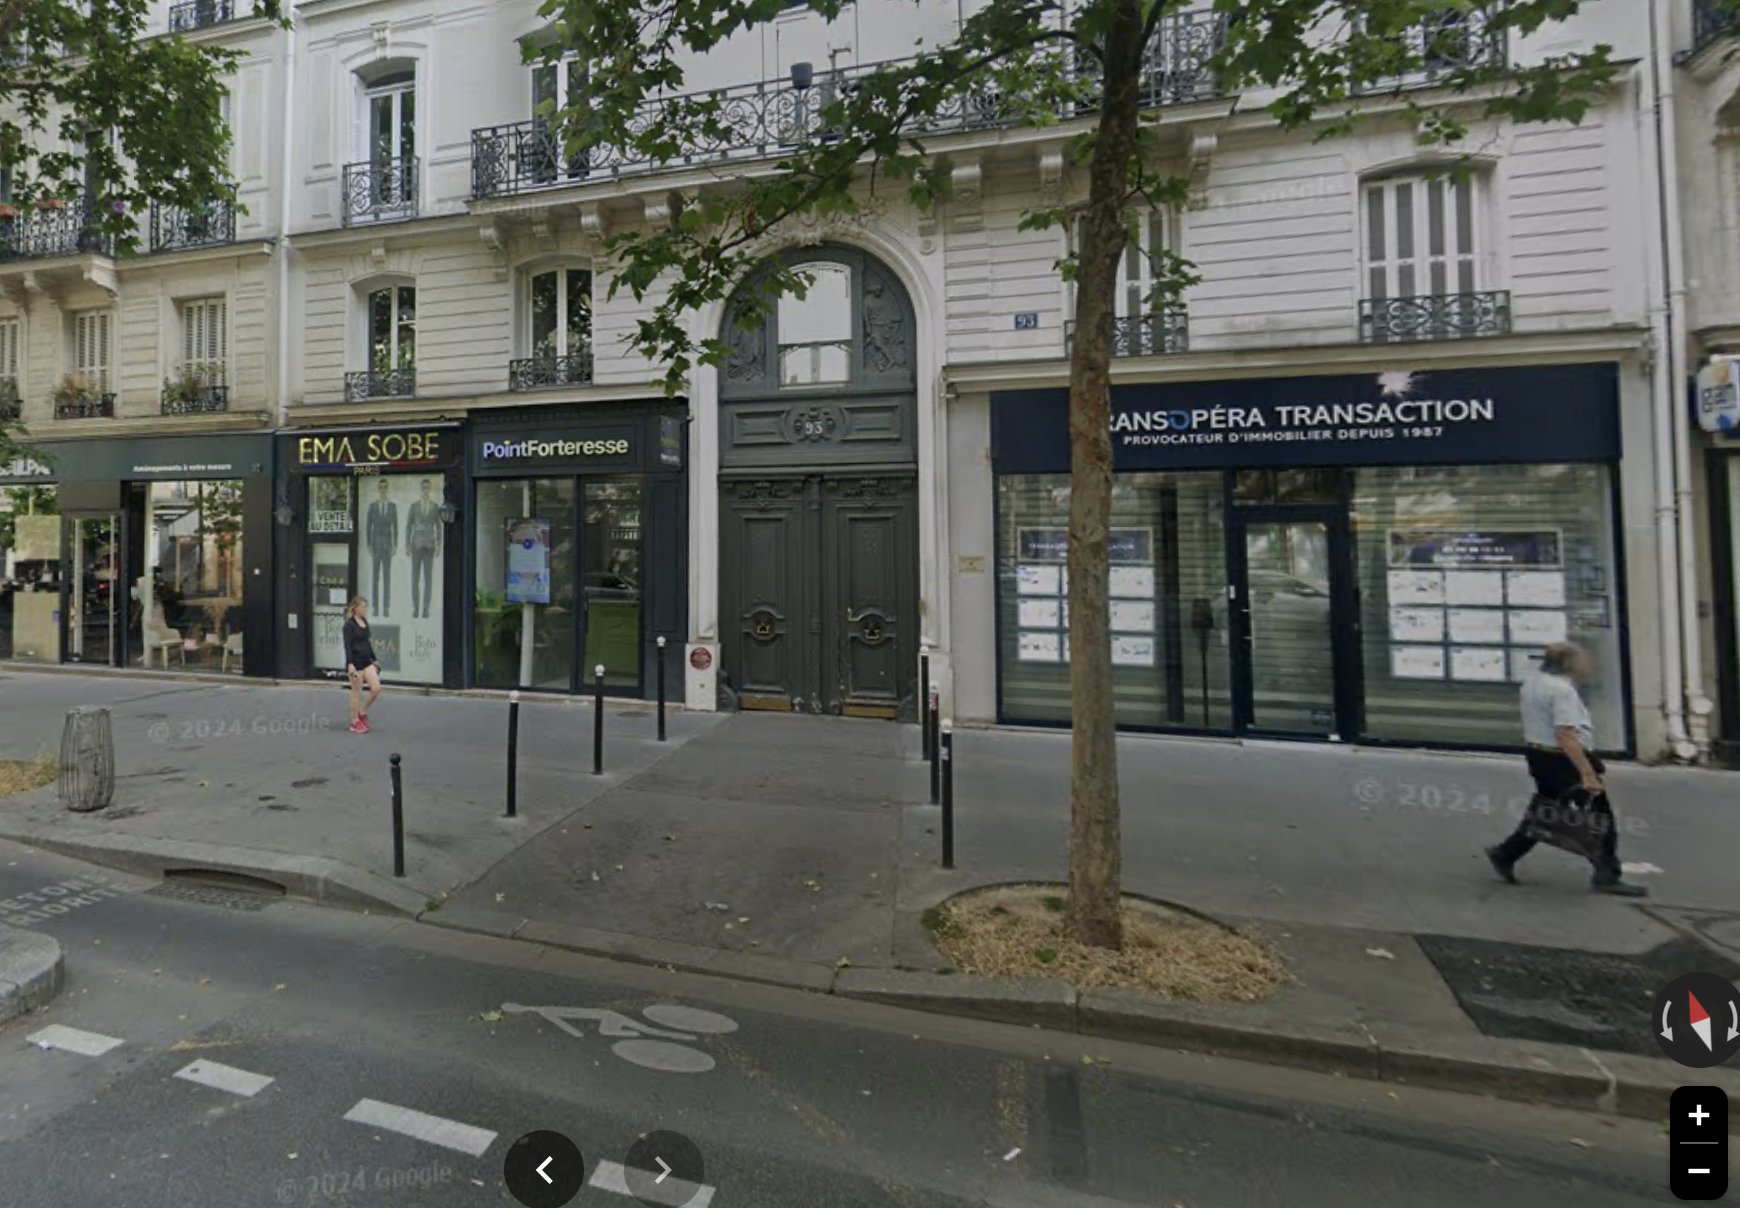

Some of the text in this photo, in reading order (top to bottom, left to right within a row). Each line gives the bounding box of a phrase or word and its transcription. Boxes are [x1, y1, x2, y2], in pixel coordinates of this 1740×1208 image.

[1110, 399, 1494, 431] ANSOPÉRA TRANSACTION
[1123, 426, 1443, 445] PROVOCATEUR D'IMMOBILIER DEPUIS 1987
[299, 432, 439, 464] EMA SOBE
[483, 438, 628, 458] PointForteresse
[353, 465, 380, 476] PARIS
[317, 510, 346, 521] VENTE
[374, 639, 396, 652] MA
